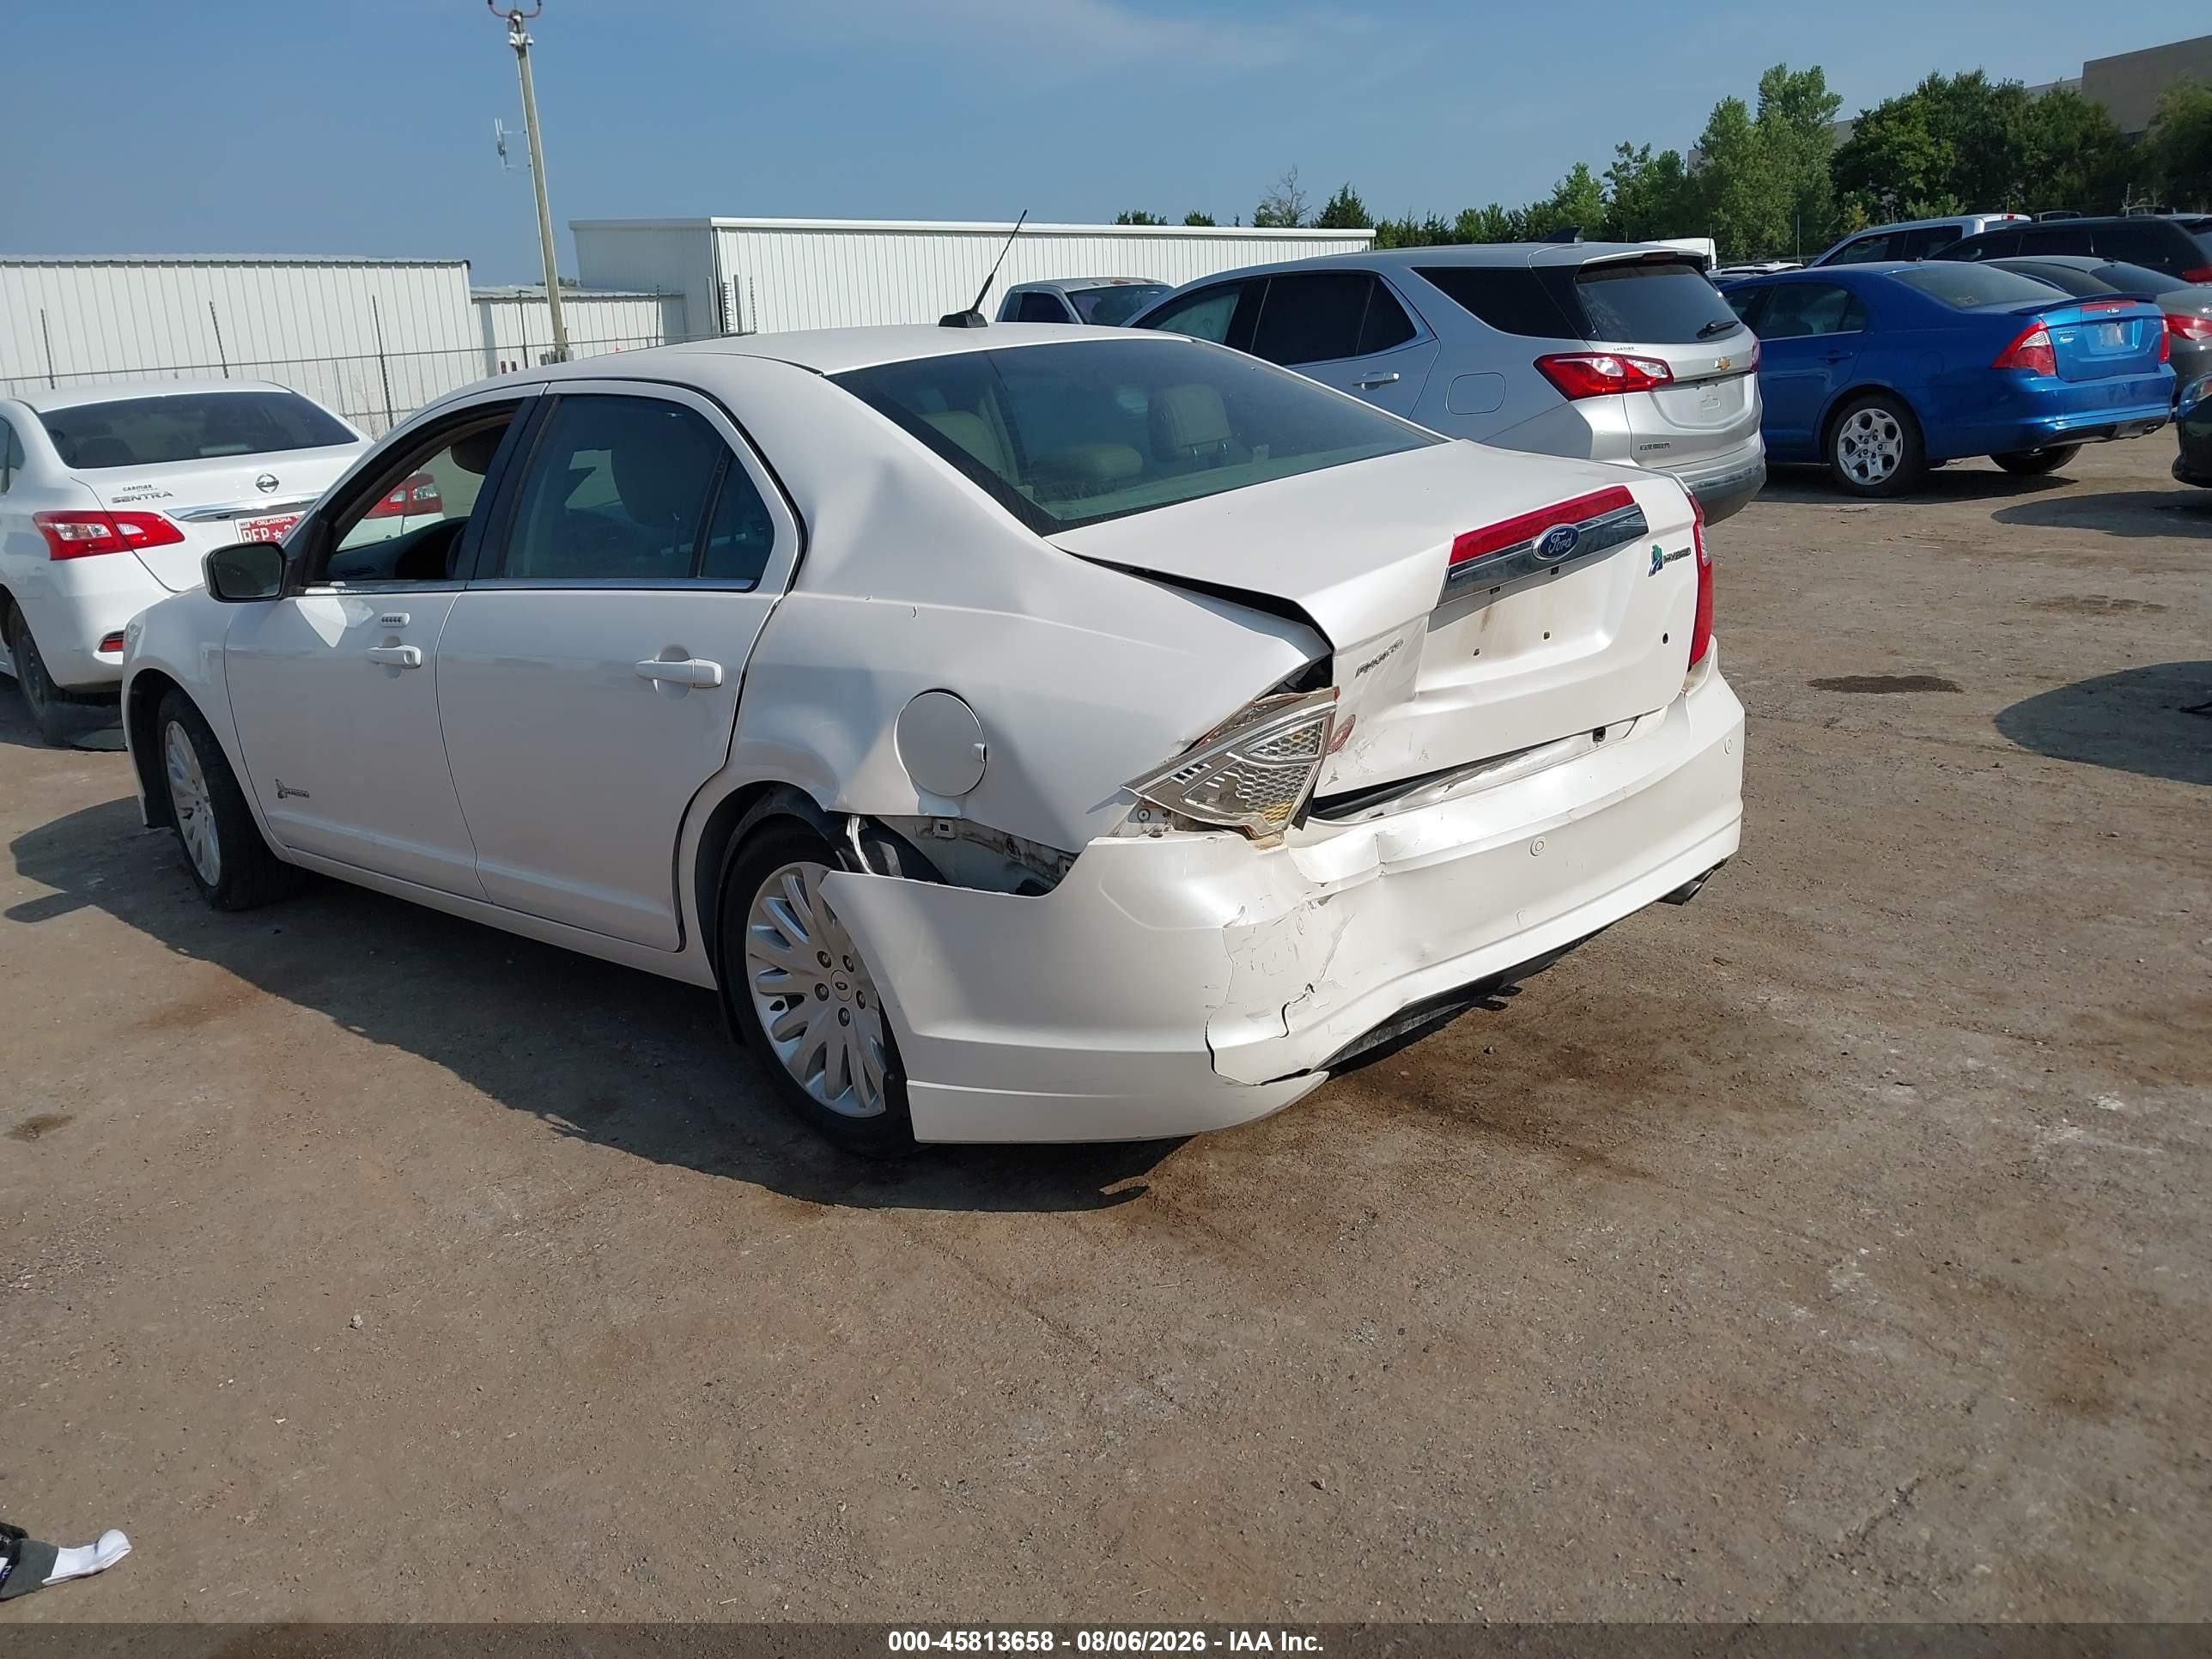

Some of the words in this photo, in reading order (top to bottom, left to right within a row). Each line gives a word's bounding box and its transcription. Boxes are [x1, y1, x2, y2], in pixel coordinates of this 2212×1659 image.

[111, 491, 174, 504] SENTRA
[256, 517, 293, 526] OKLAHOMA
[1547, 529, 1574, 555] Ford
